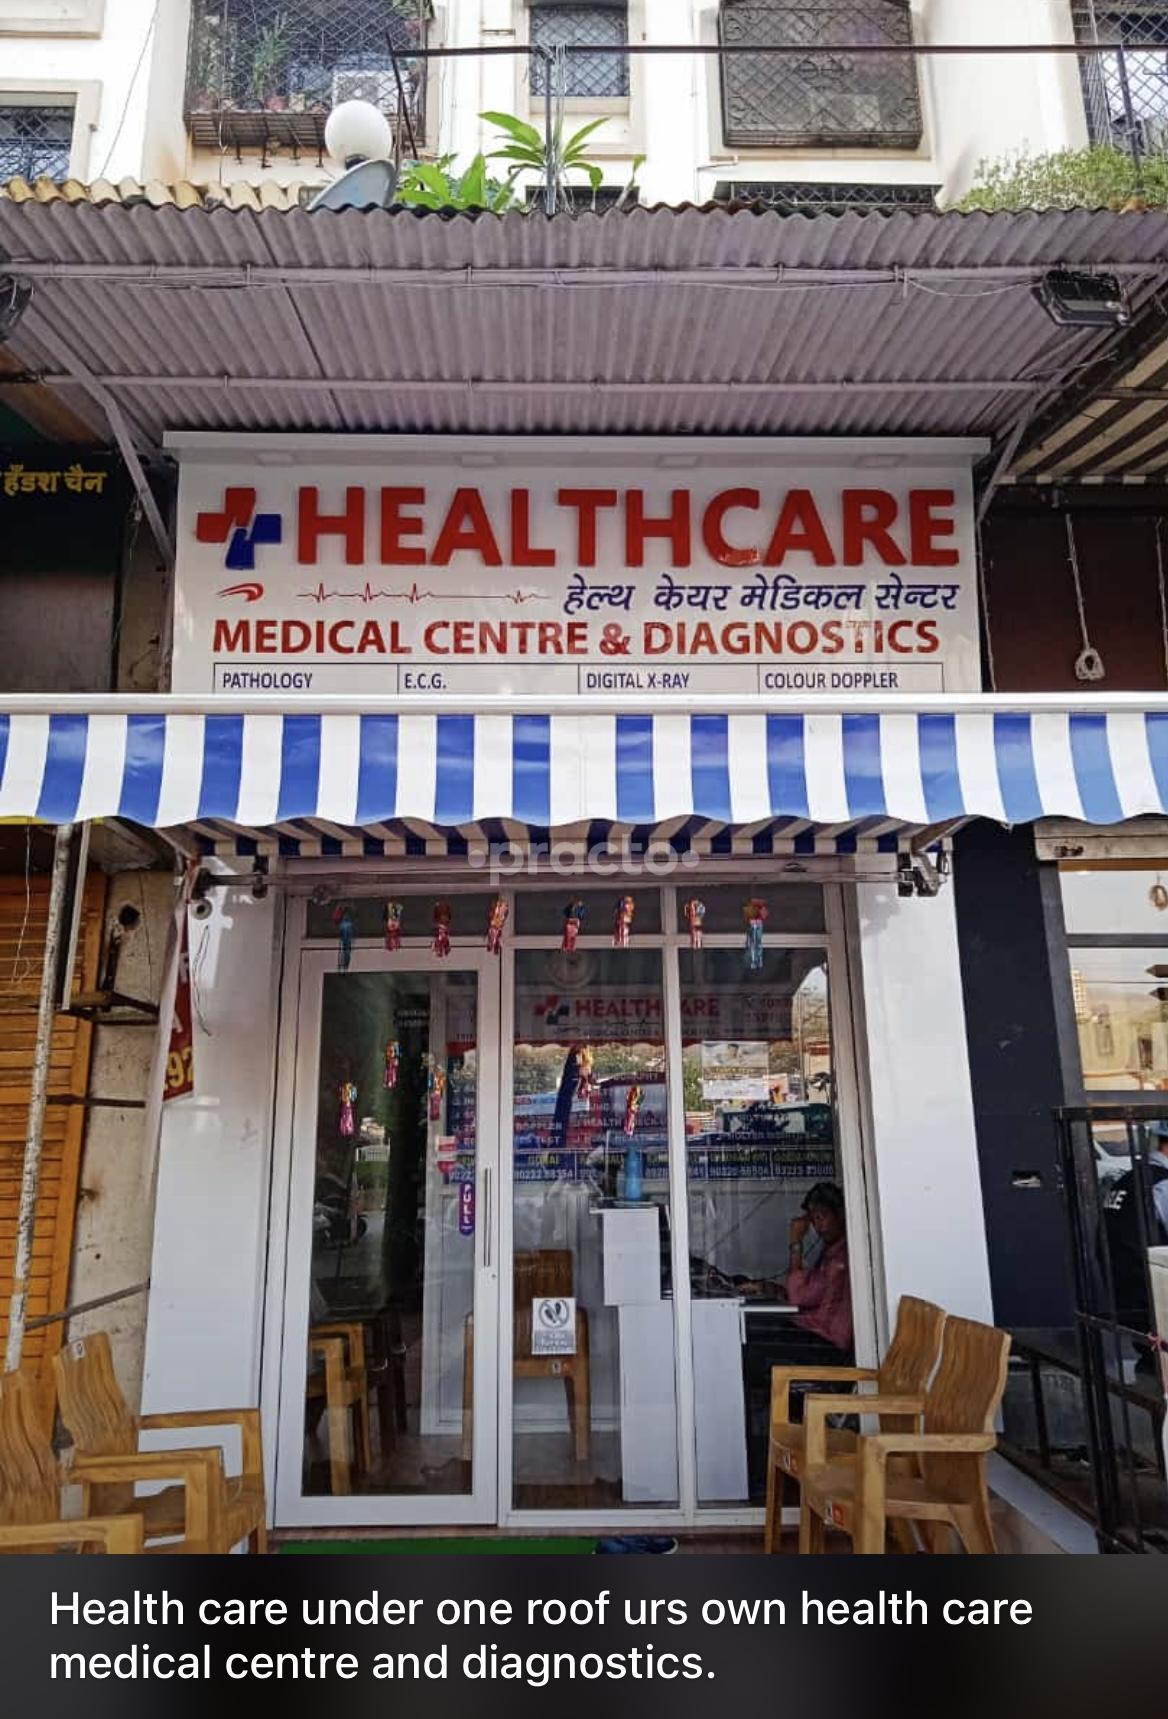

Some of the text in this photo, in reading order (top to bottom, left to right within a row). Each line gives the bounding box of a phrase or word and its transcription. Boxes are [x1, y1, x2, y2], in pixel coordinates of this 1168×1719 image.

[297, 487, 959, 568] HEALTHCARE
[563, 572, 960, 615] हेल्थ केयर मेडिकल सेन्टर
[213, 619, 940, 656] MEDICAL CENTRE & DIAGNOSTICS
[223, 672, 313, 689] PATHOLOGY
[404, 673, 447, 689] E.C.G.
[586, 673, 690, 689] DIGITAL X-RAY
[765, 672, 898, 689] COLOUR DOPPLER
